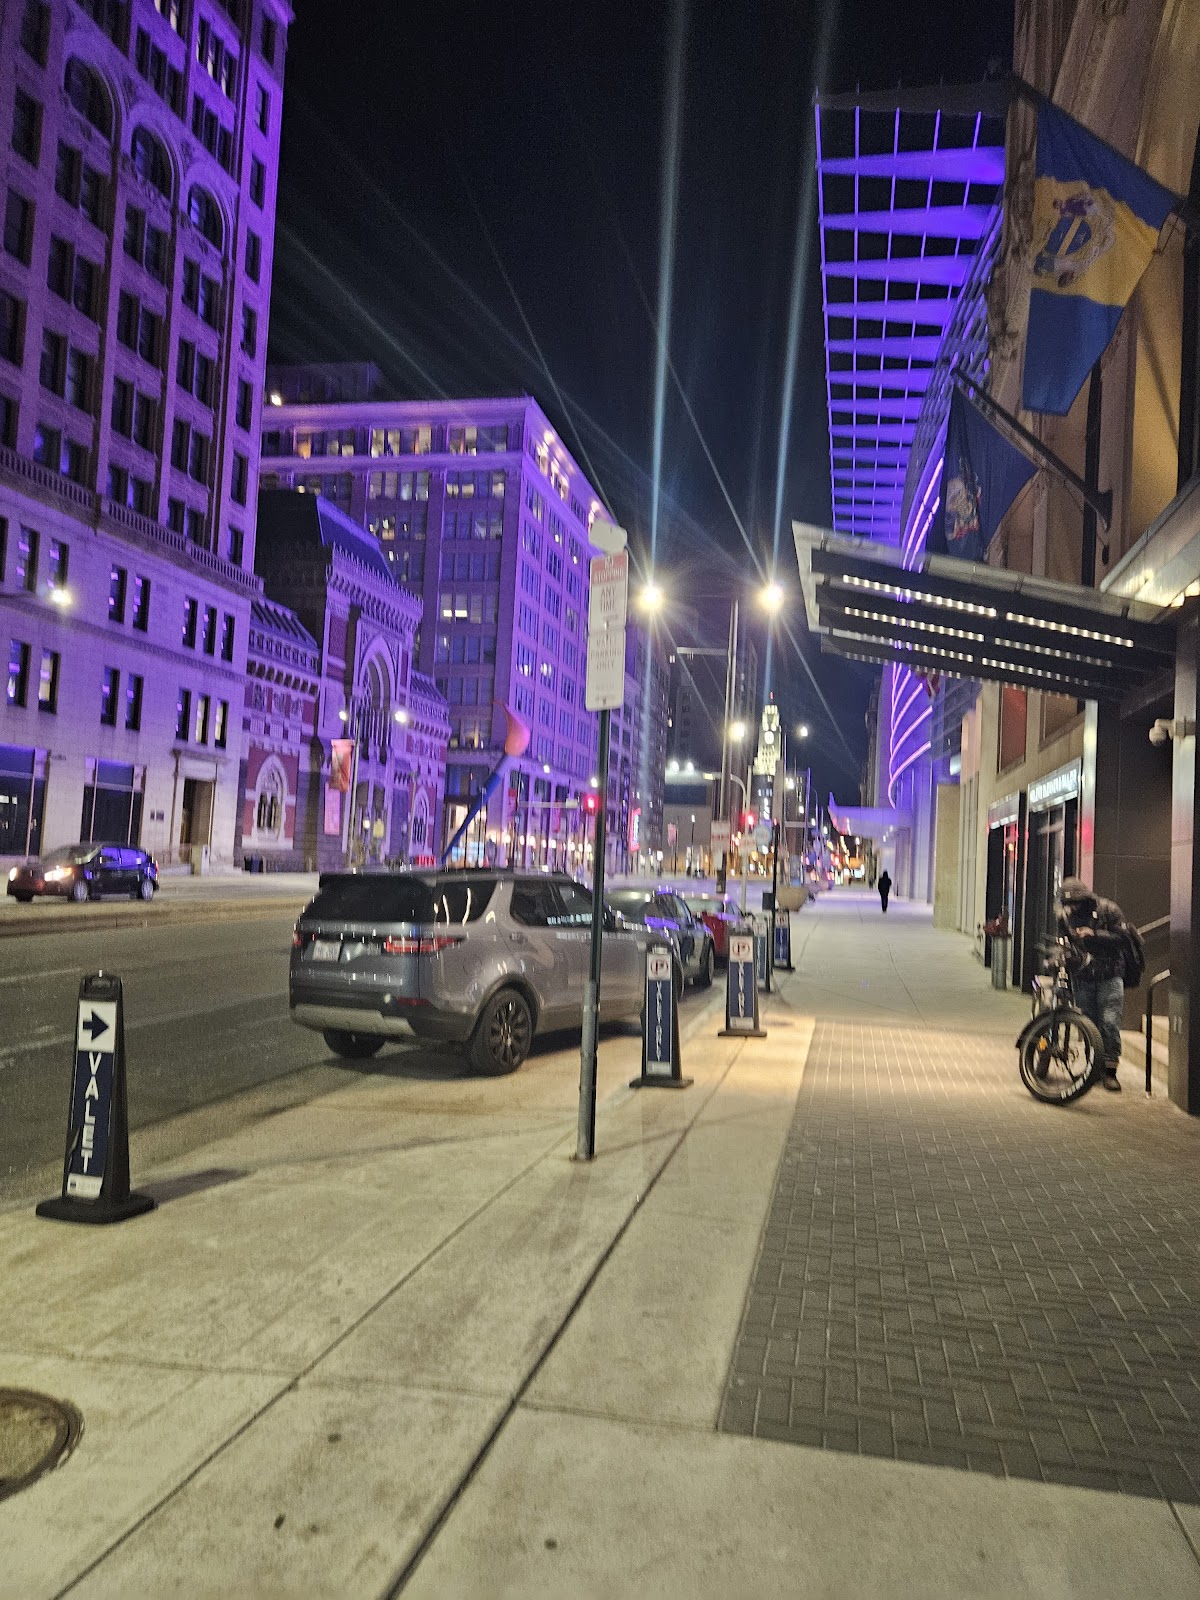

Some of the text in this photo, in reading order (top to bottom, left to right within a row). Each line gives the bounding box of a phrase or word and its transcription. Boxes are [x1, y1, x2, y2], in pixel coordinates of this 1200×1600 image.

[601, 584, 617, 598] ANY
[590, 648, 622, 660] PARKING
[81, 1052, 102, 1174] VALET
